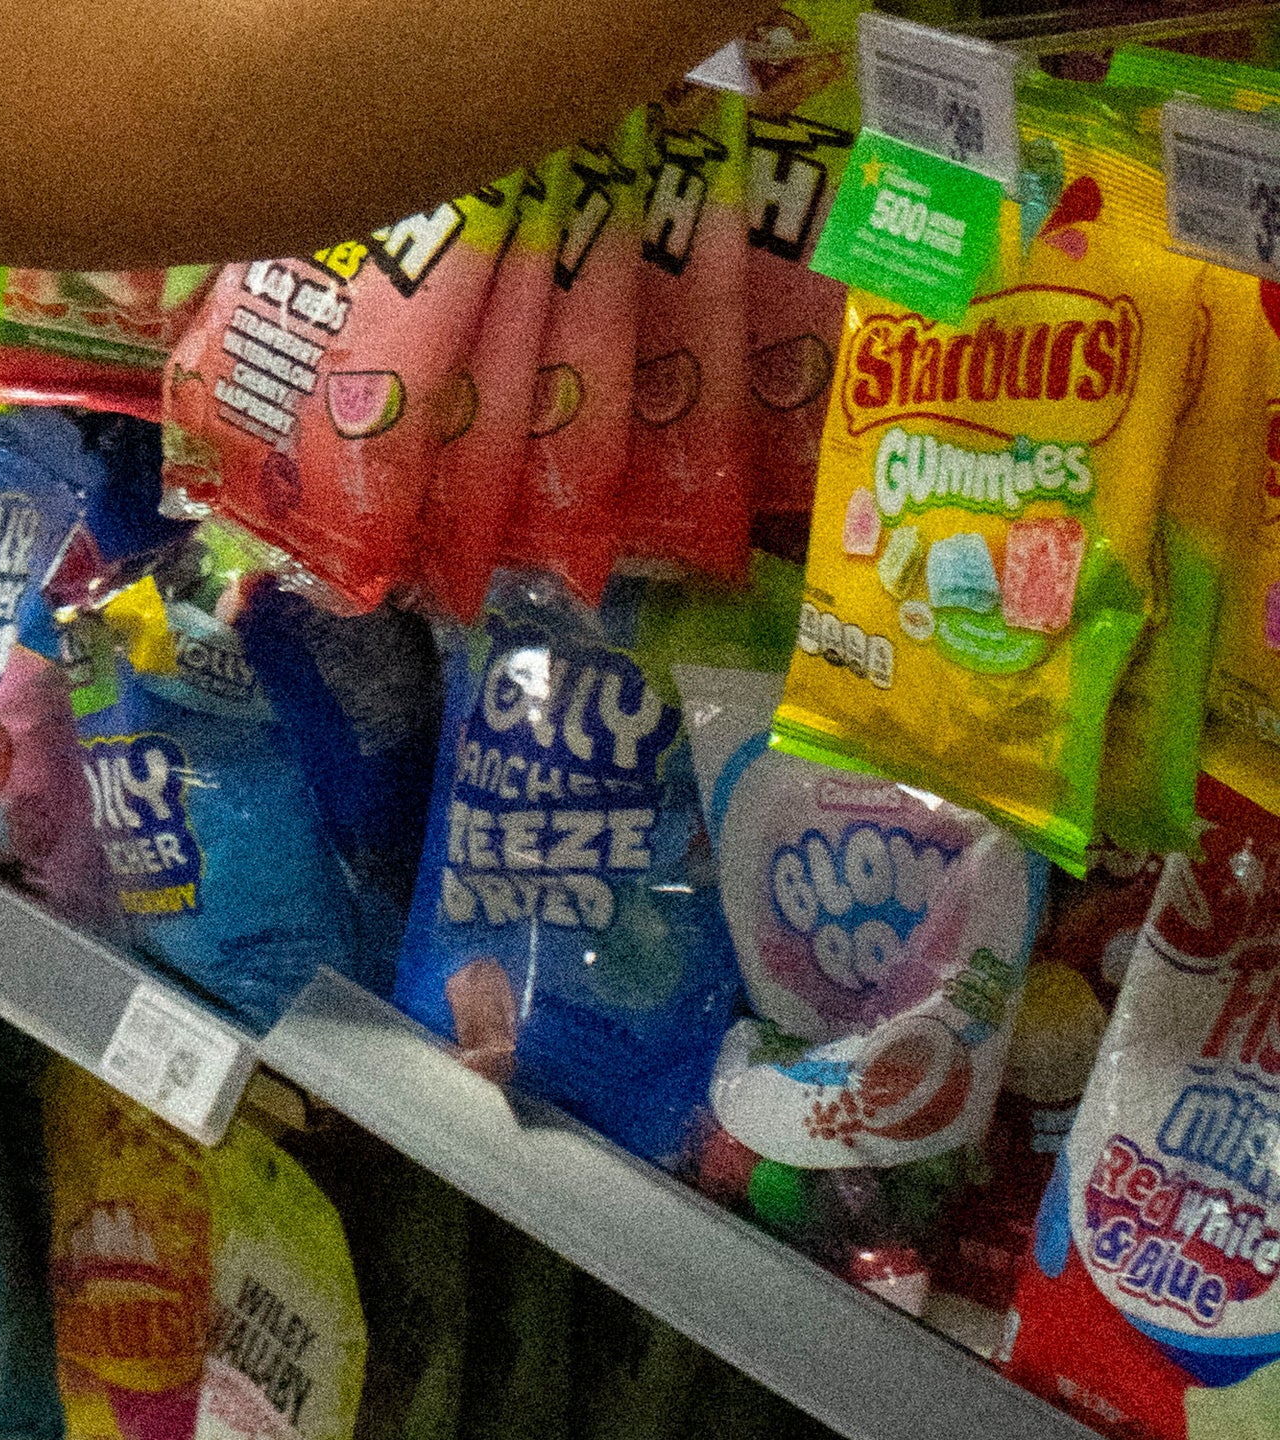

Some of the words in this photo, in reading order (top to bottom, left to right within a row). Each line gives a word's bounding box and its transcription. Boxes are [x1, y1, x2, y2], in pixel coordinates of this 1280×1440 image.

[870, 189, 928, 242] 500
[852, 303, 1133, 407] Starburst
[178, 638, 258, 686] OLLY
[484, 648, 662, 770] OLLY
[1095, 1138, 1180, 1223] Red
[1174, 1186, 1280, 1274] White
[239, 1277, 319, 1361] WILEY
[1093, 1218, 1132, 1272] &
[1124, 1233, 1224, 1323] Blue
